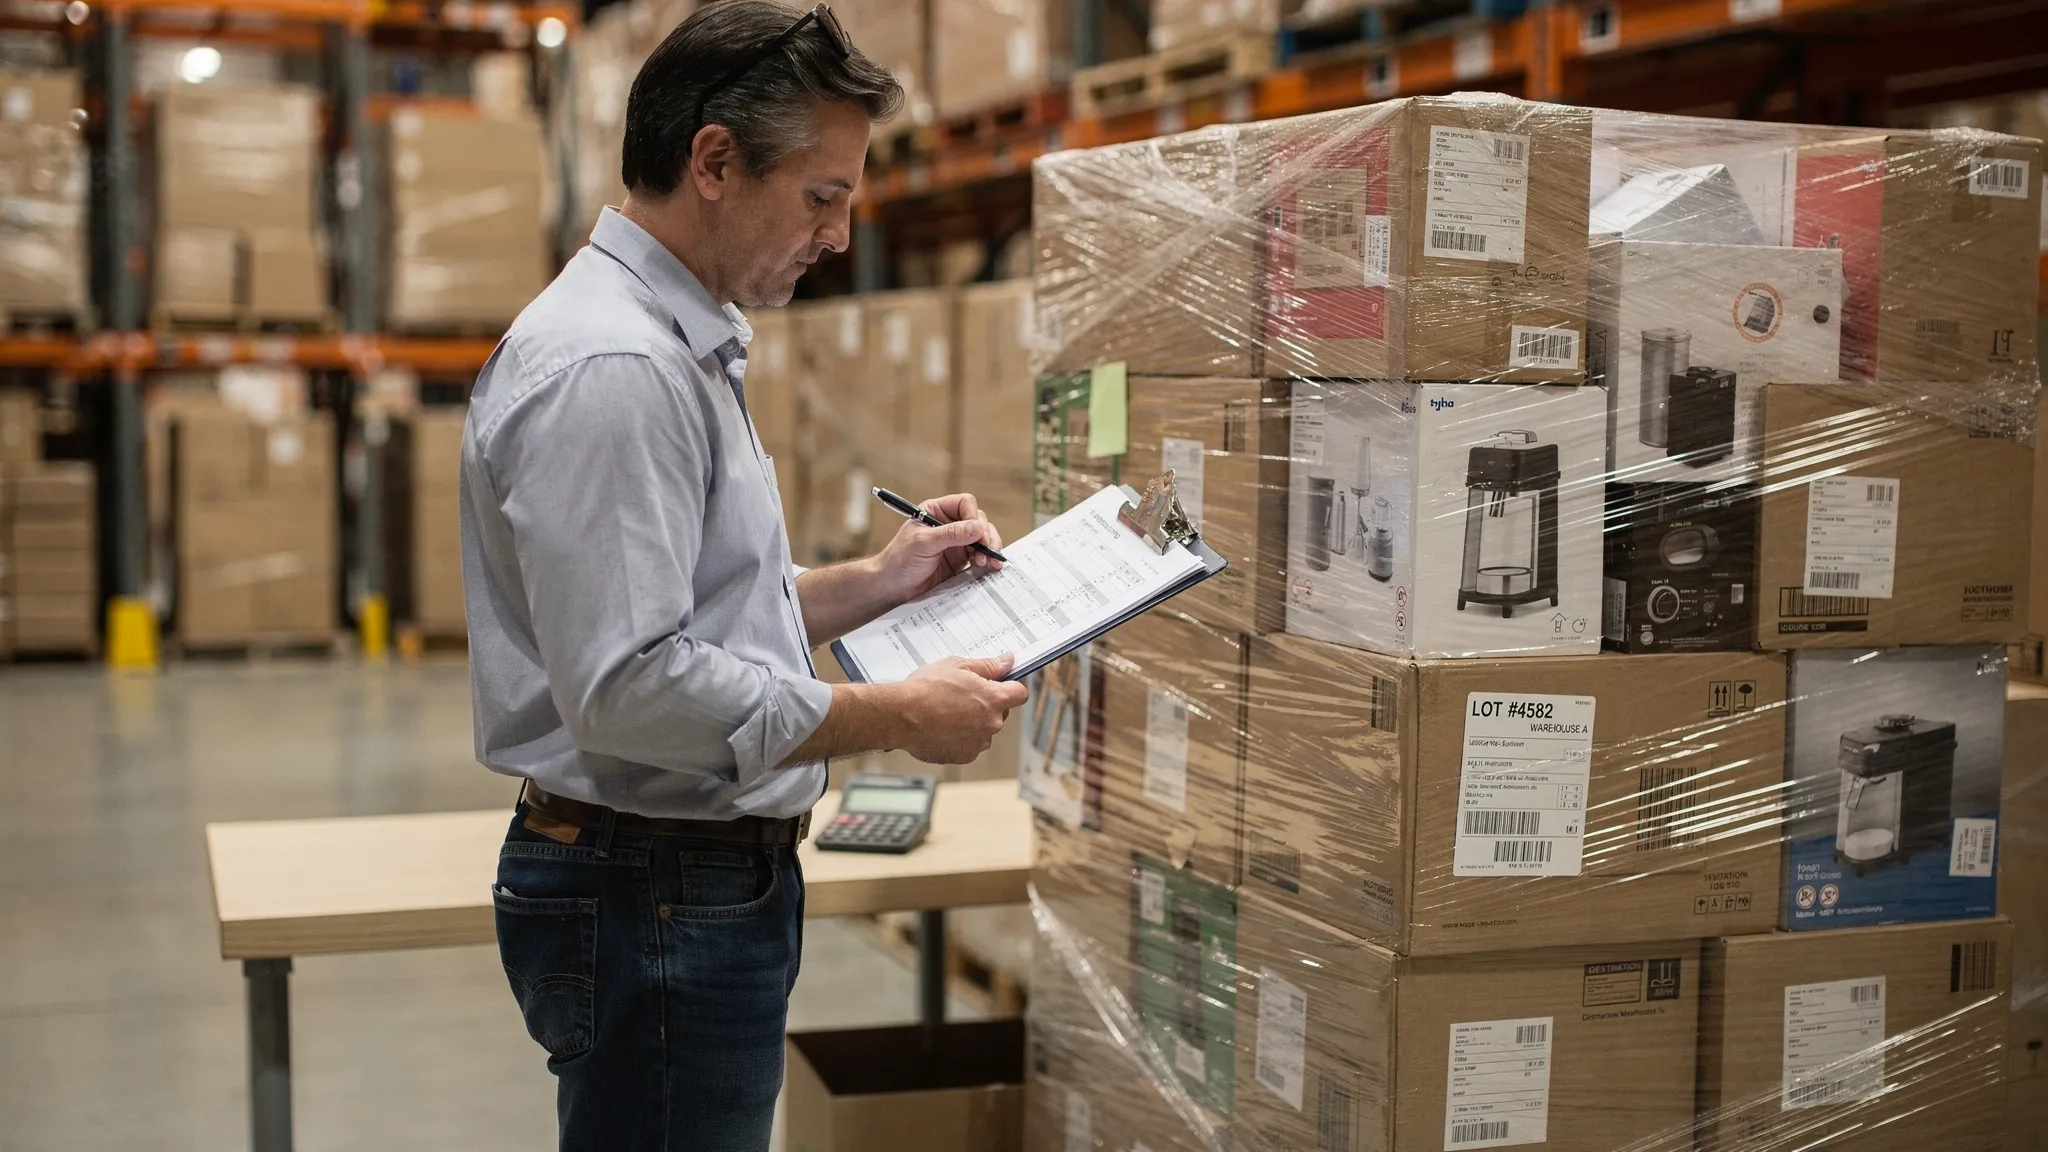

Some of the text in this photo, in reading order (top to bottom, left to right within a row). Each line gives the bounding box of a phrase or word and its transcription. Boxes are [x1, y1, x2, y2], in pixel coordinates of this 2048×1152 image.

[1472, 701, 1554, 719] LOT #4582
[1582, 725, 1588, 733] A
